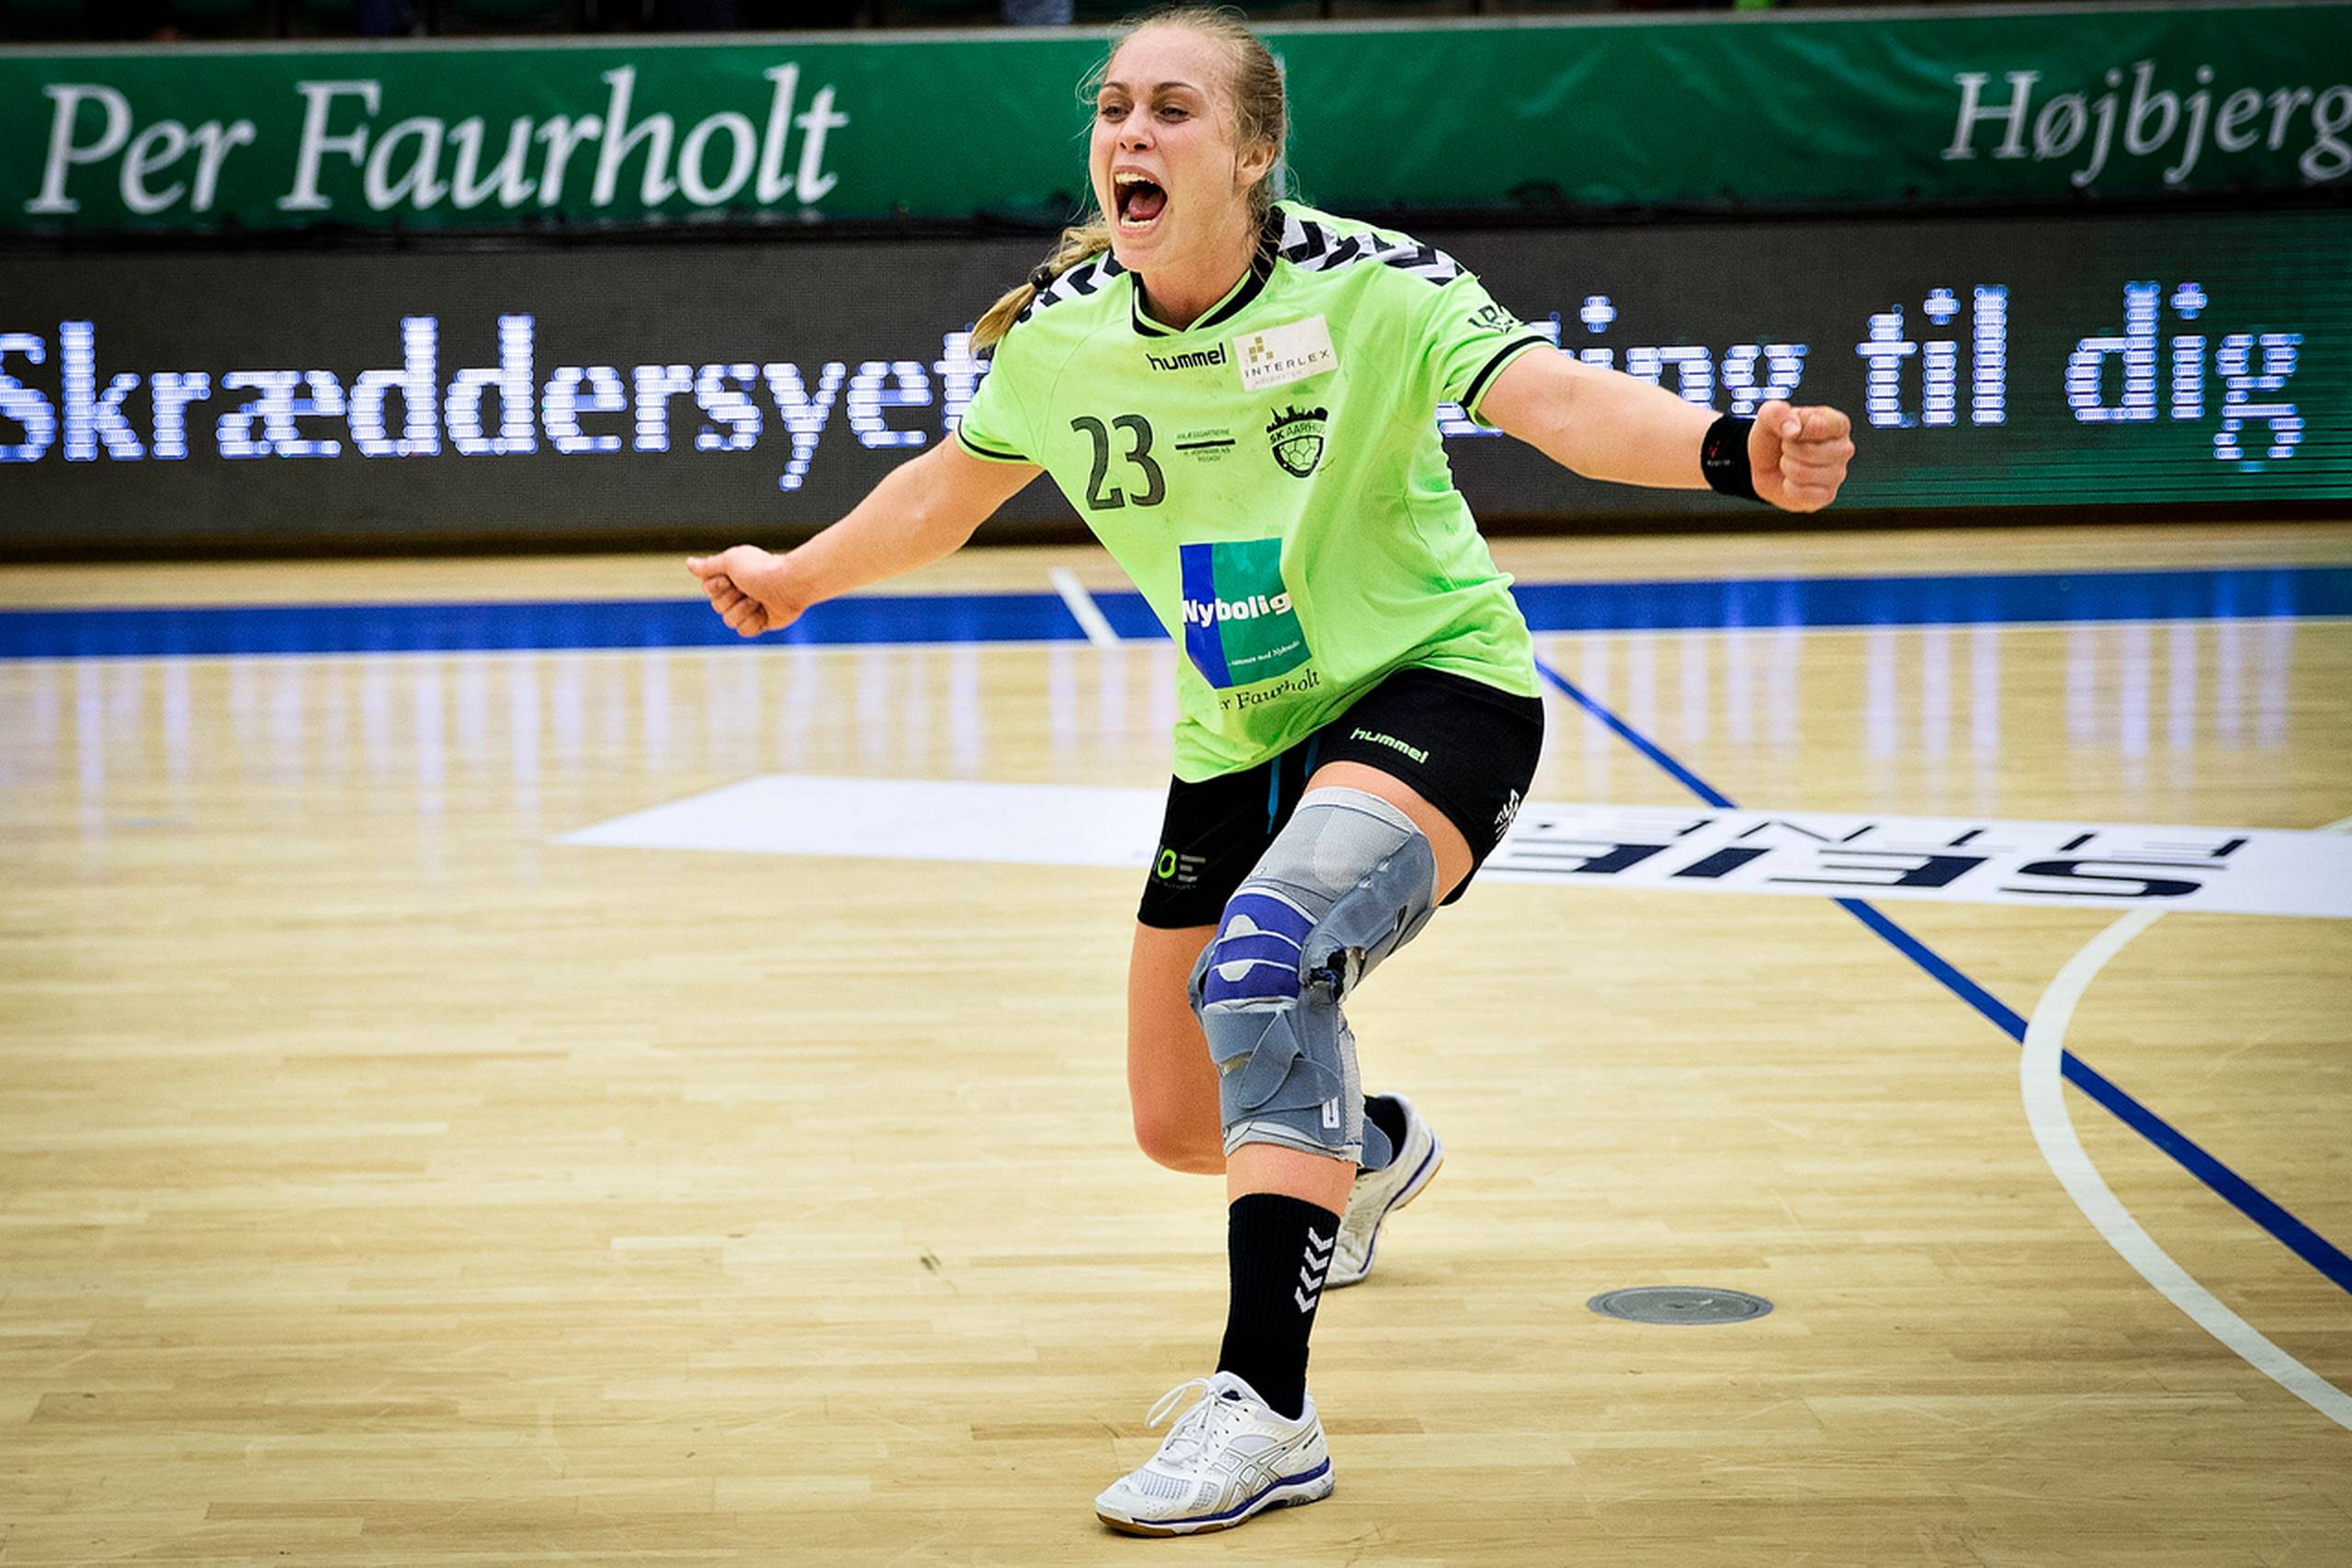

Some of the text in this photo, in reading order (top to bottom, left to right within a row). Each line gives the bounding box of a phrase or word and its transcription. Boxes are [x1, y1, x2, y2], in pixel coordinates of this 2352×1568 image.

[25, 62, 849, 215] Per Faurholt
[1942, 59, 2352, 186] Højbjerg
[1146, 342, 1227, 371] hummel
[1245, 348, 1330, 378] INTERLEX
[1856, 283, 2008, 429] til
[2064, 280, 2305, 472] dig
[0, 313, 990, 492] Skræddersyet
[1070, 414, 1166, 511] 23
[1270, 429, 1285, 446] SK
[1182, 592, 1294, 628] Nybolig
[1236, 668, 1321, 710] Faurholt
[1350, 727, 1430, 764] hummel
[1479, 838, 2228, 898] SEIE
